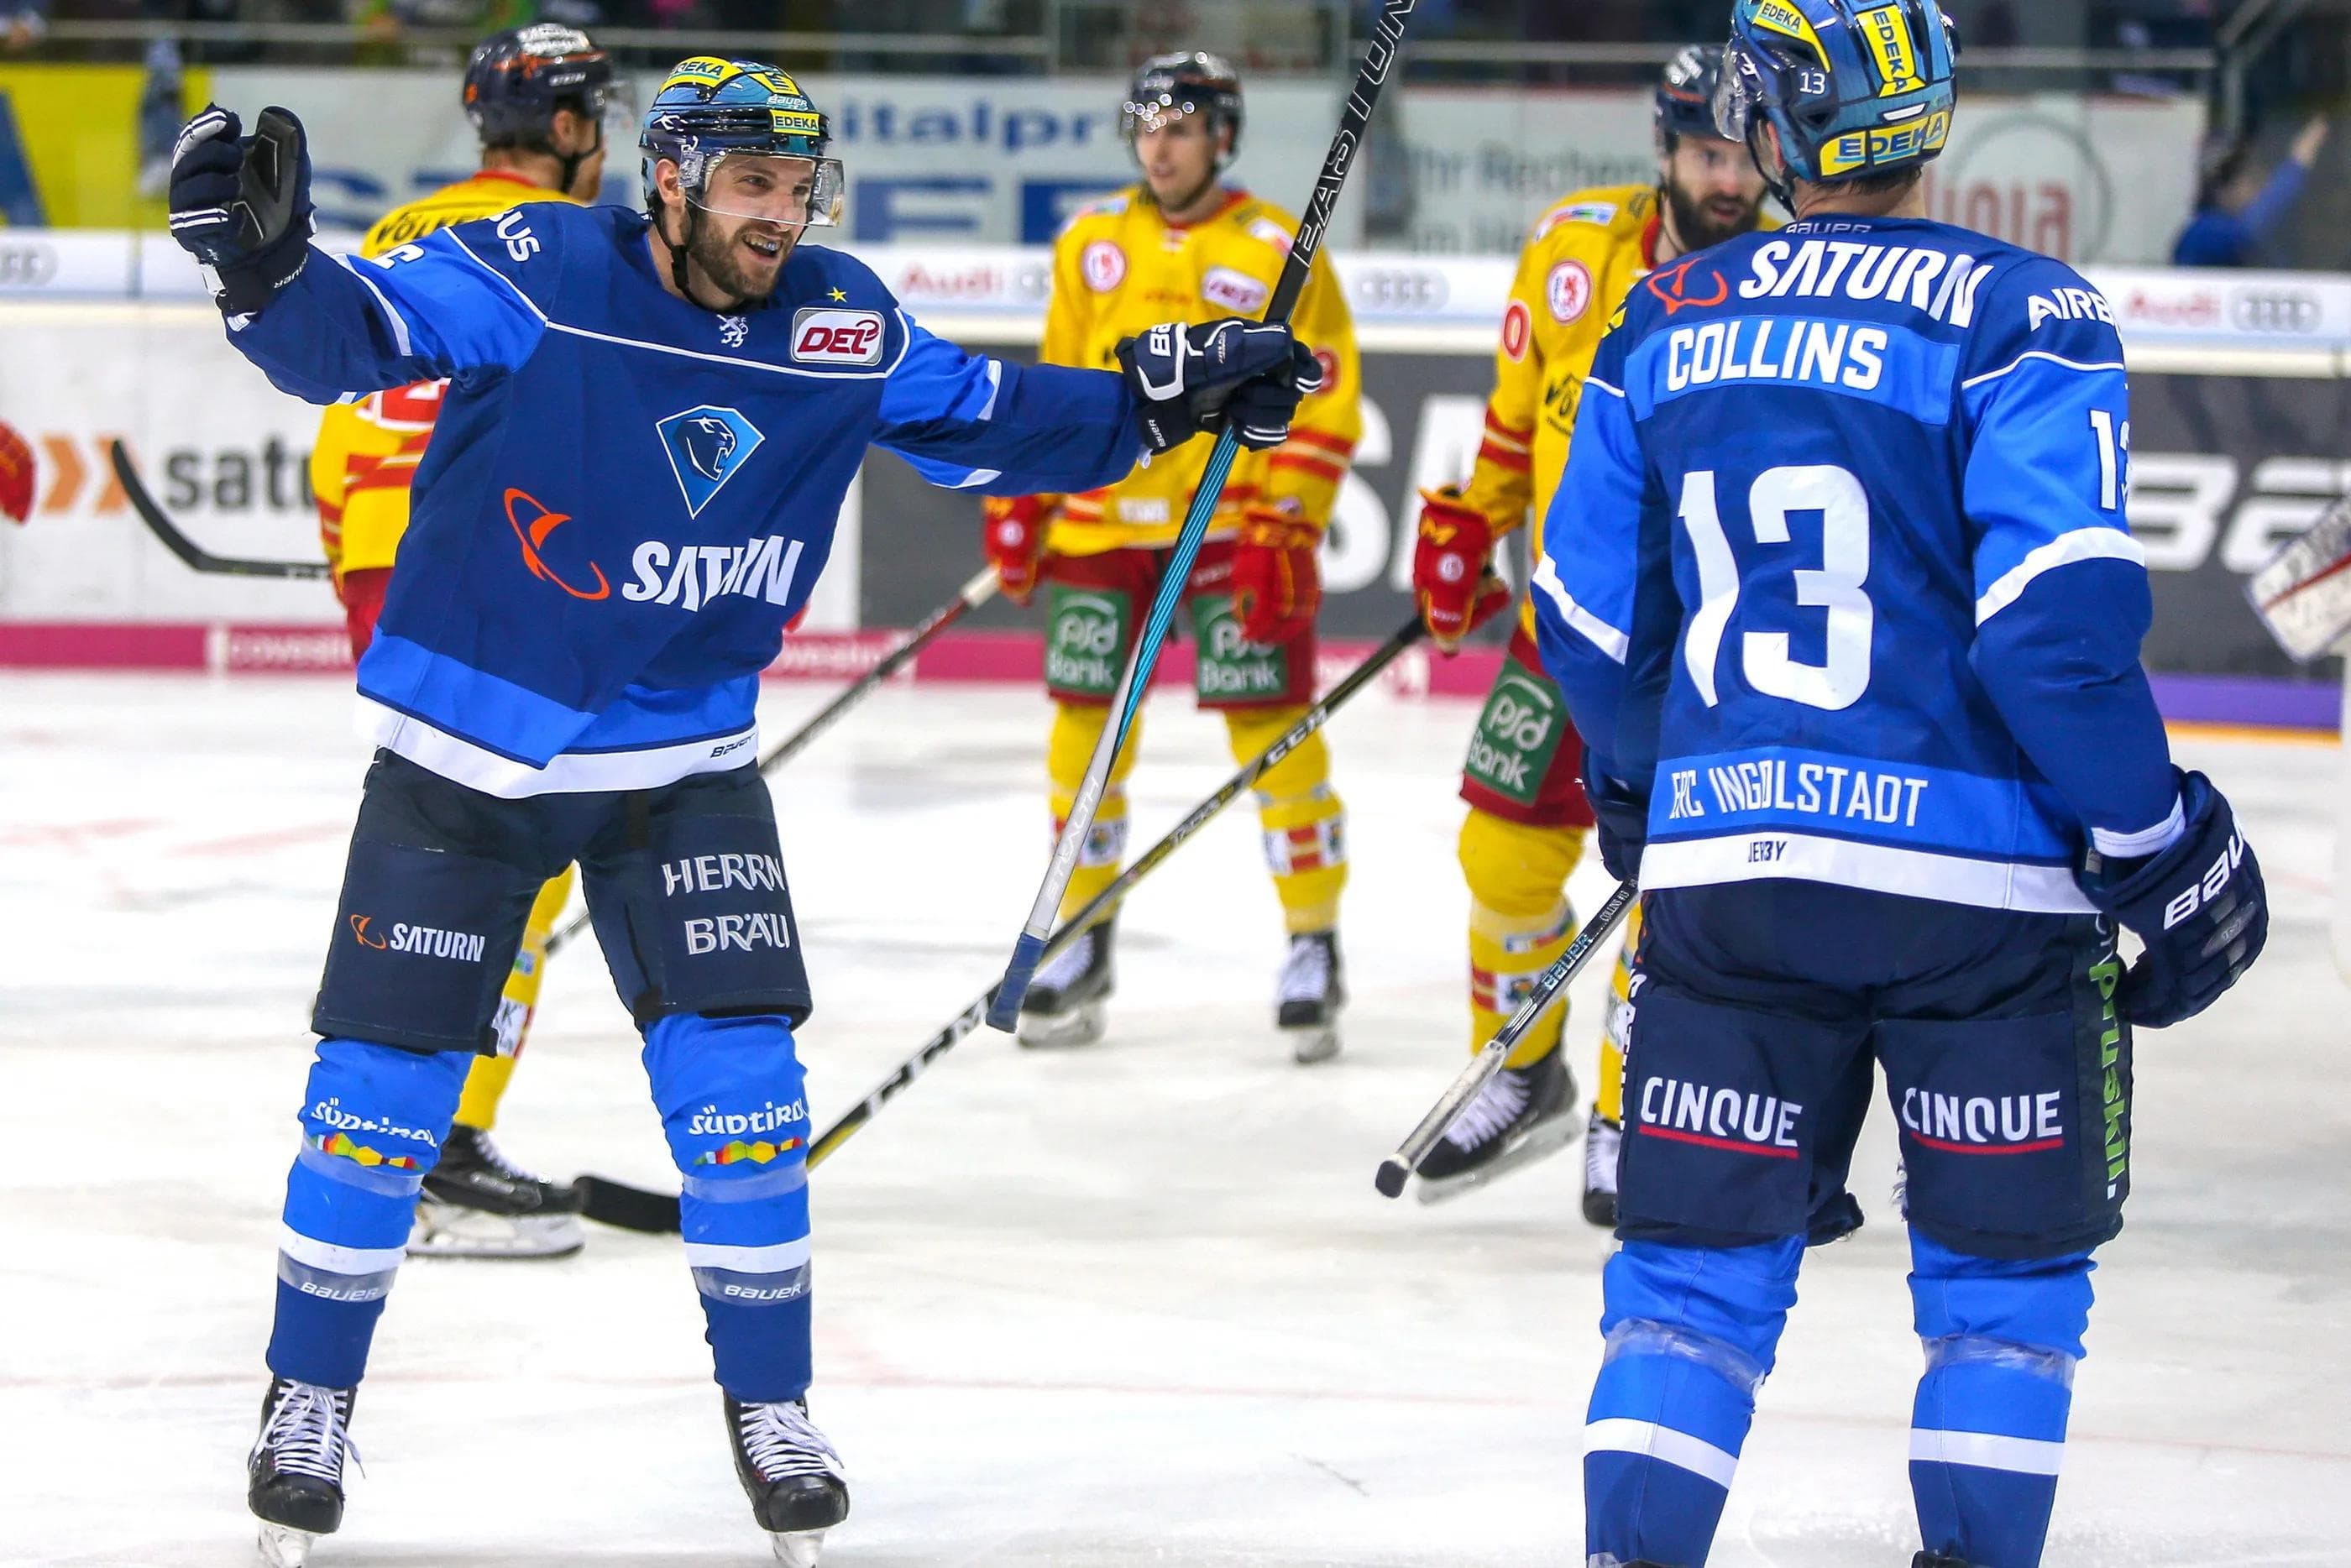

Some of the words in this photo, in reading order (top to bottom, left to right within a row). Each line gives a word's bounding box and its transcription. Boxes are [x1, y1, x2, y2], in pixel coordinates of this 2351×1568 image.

[1762, 3, 1801, 30] EDEKA
[1873, 11, 1909, 92] EDEKA
[1799, 72, 1826, 94] 13
[775, 116, 819, 129] EDEKA
[1839, 115, 1944, 156] EDEKA
[489, 209, 542, 262] US
[1737, 239, 1993, 328] SATURN
[797, 319, 879, 354] DEL
[1668, 320, 1888, 391] COLLINS
[1678, 464, 1874, 711] 13
[1708, 759, 1929, 827] INGOLSTADT
[661, 853, 786, 897] HERRN
[1599, 896, 1623, 923] COLLINS
[390, 922, 485, 964] SATURN
[684, 912, 791, 956] BRÄU
[1640, 1075, 1803, 1148] CINQUE
[1902, 1086, 2063, 1143] CINQUE
